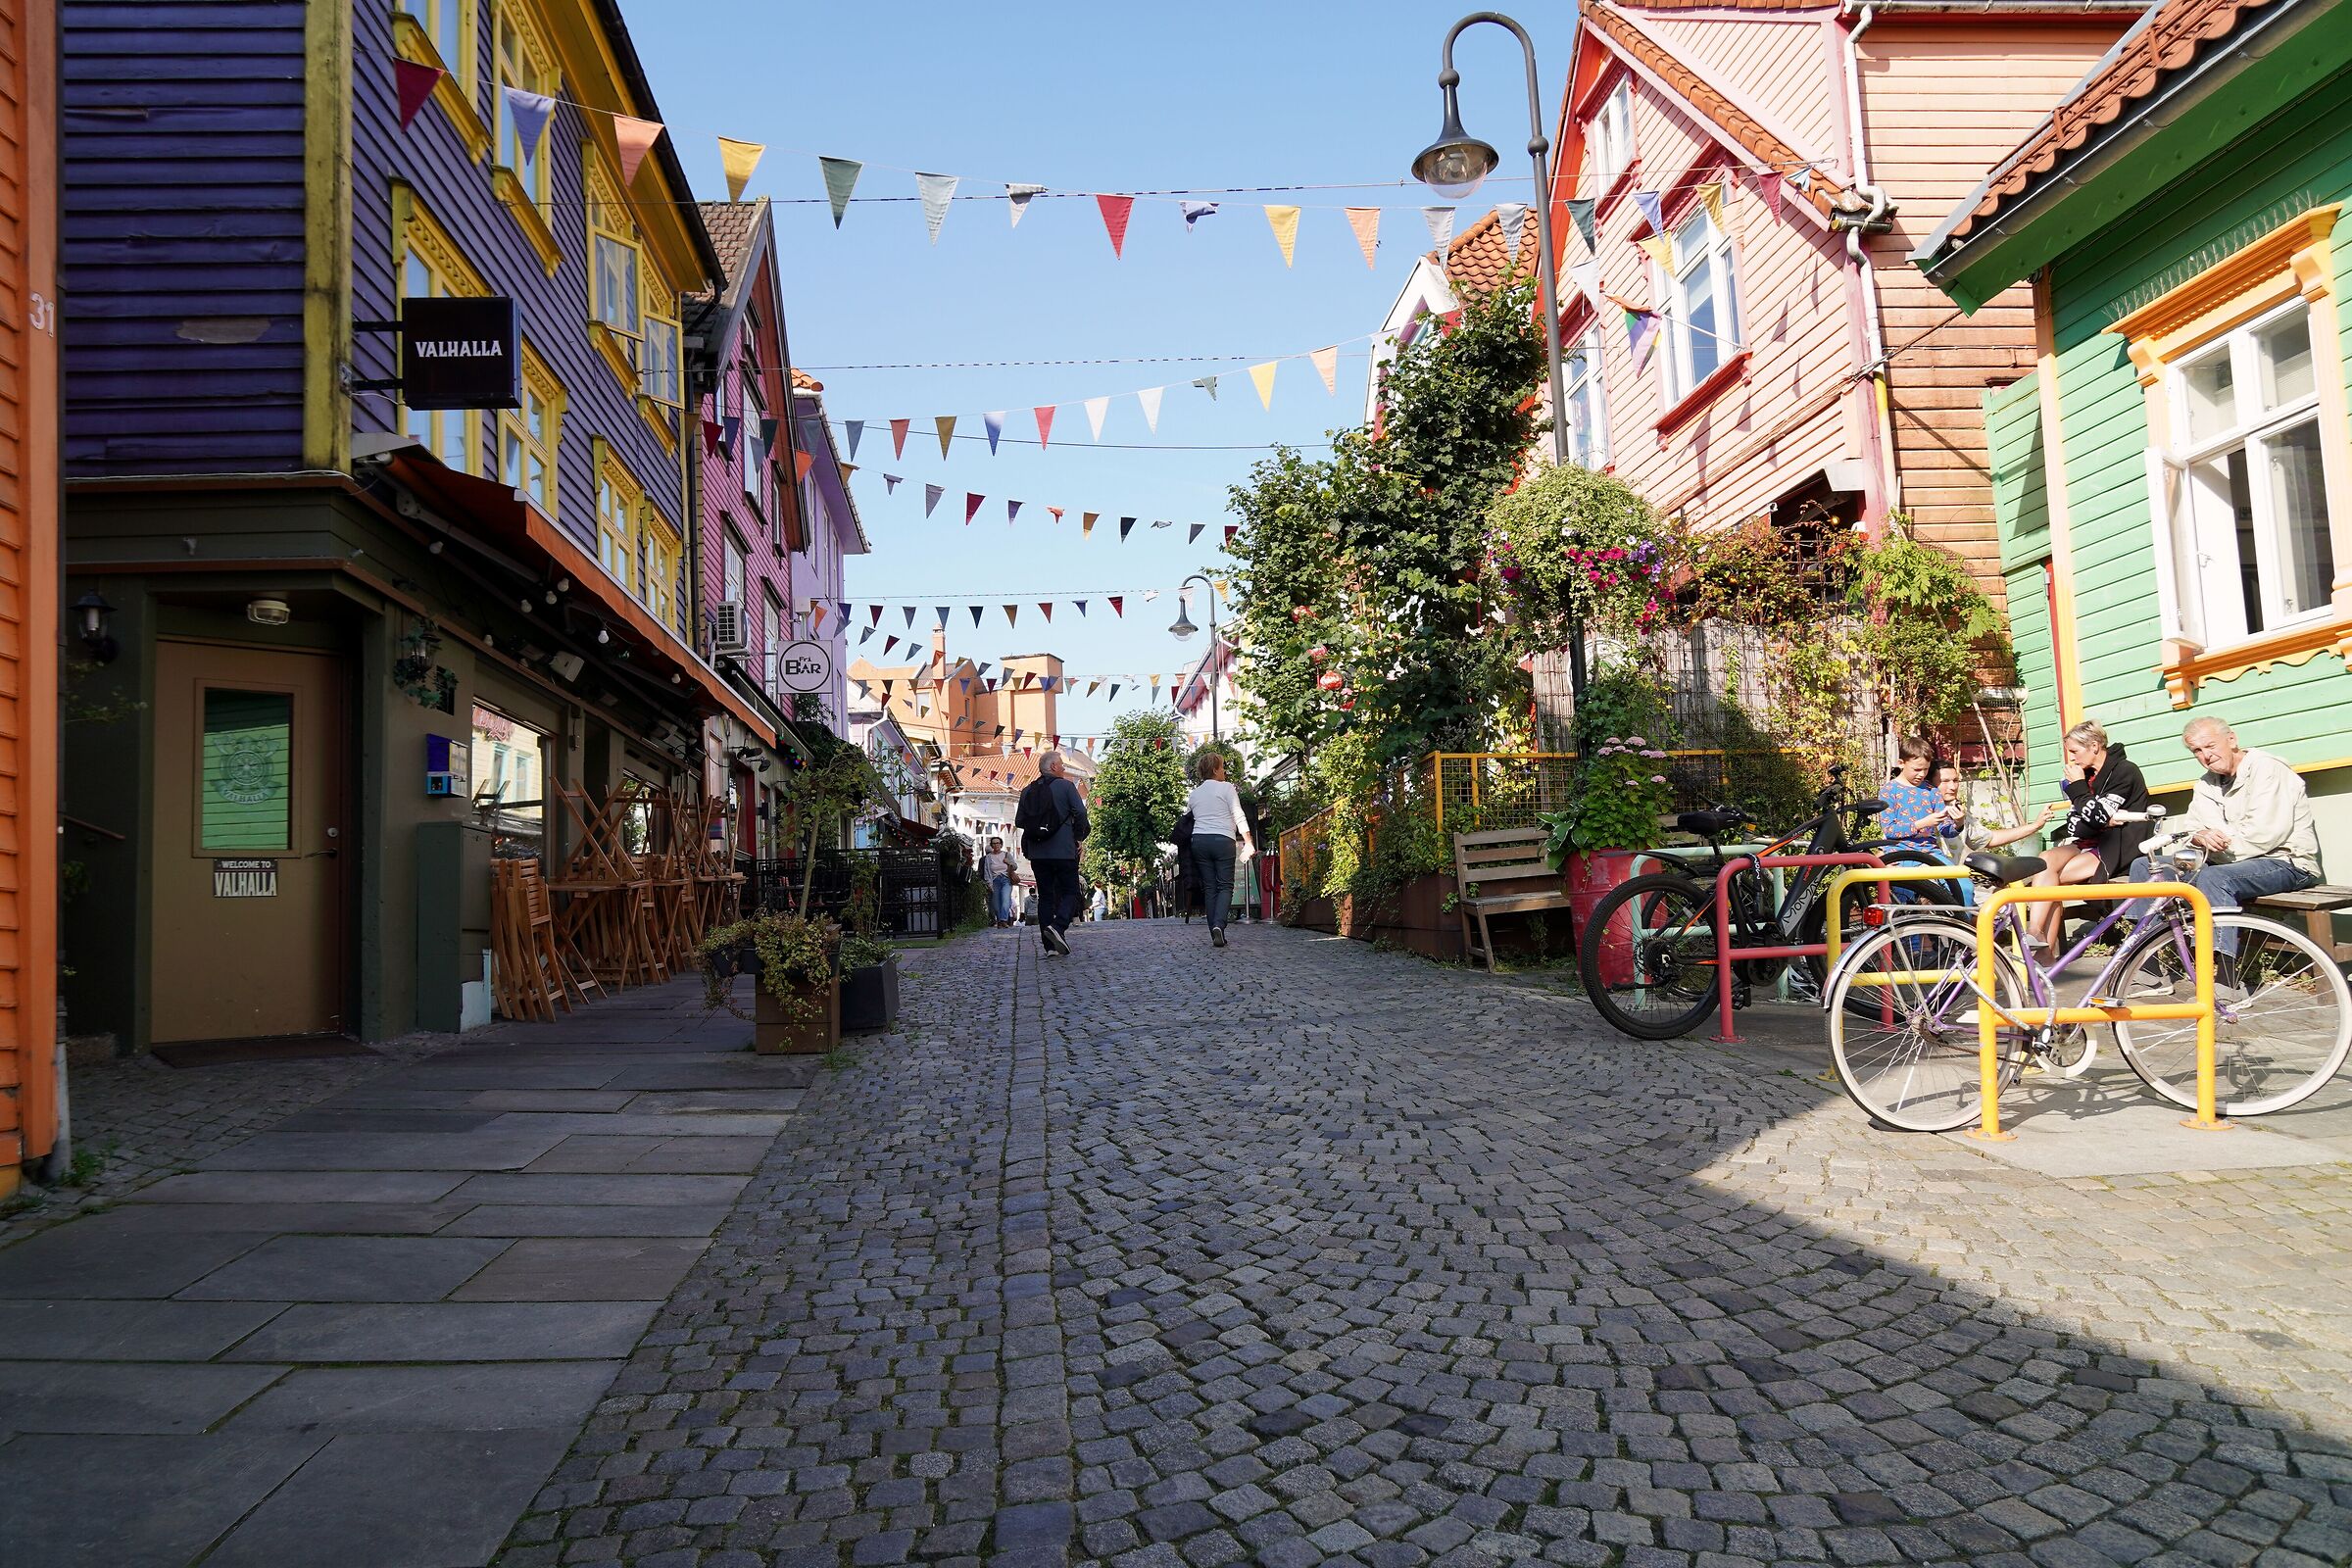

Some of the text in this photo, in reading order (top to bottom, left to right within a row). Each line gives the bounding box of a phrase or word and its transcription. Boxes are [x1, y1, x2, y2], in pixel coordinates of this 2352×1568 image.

[30, 293, 54, 337] 31
[415, 340, 503, 358] VALHALLA
[785, 660, 821, 675] BAR
[221, 860, 271, 869] WELCOME TO
[214, 871, 277, 897] VALHALLA
